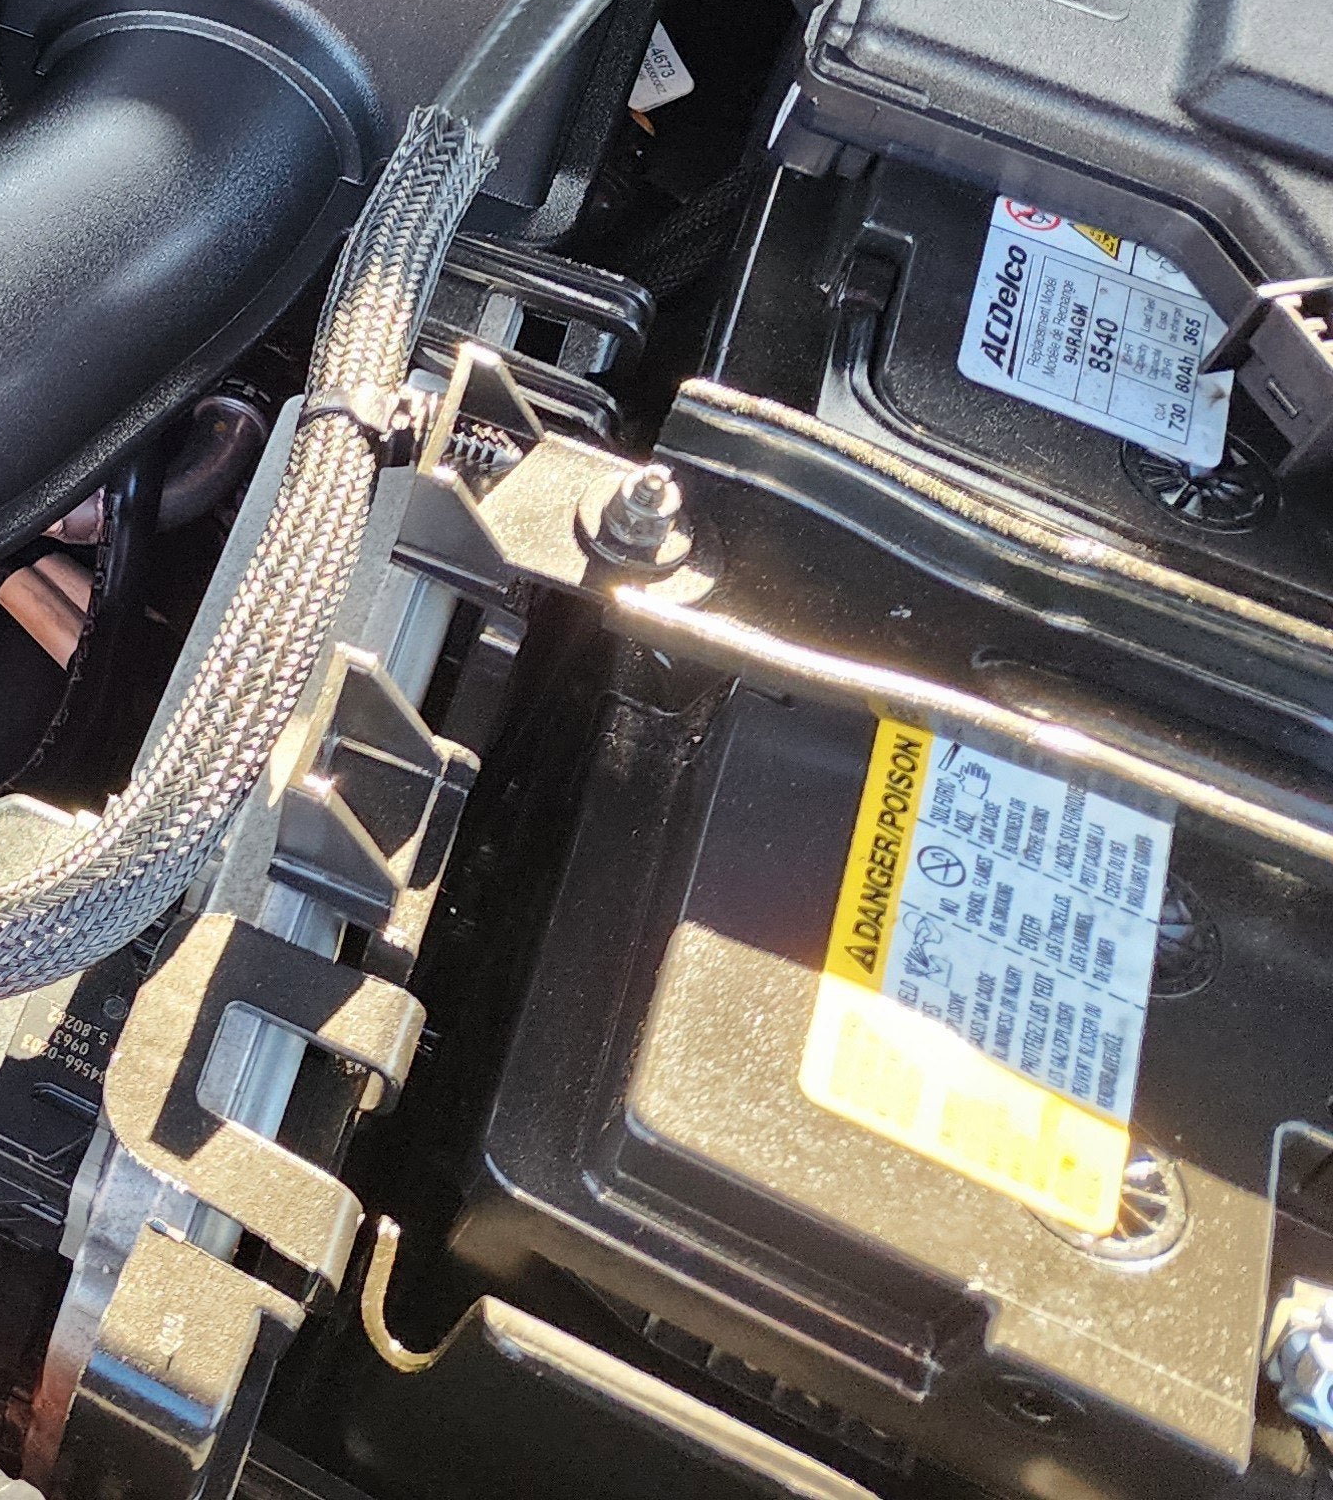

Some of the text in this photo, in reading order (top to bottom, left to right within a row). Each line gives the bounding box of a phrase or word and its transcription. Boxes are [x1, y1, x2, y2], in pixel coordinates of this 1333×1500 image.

[980, 244, 1028, 369] ACDelco
[1051, 278, 1075, 326] Rechange
[1026, 275, 1057, 367] Replacement Model
[1049, 327, 1062, 342] de
[1063, 301, 1089, 365] 94RAGM
[1183, 317, 1200, 345] 365
[1086, 316, 1118, 373] 8540
[1173, 354, 1194, 393] 80Ah
[1168, 403, 1186, 431] 730
[930, 777, 956, 824] SULFURIC
[854, 733, 922, 945] DANGER/POISON
[977, 798, 1001, 845] CAN CAUSE
[1001, 797, 1026, 854] BLINDNESS OR
[972, 854, 993, 889] FLAMES
[1052, 839, 1075, 877] L'ACIDE
[1078, 864, 1097, 888] PEUT
[1088, 822, 1104, 836] LA
[1107, 856, 1124, 871] OU
[938, 896, 960, 916] NO
[988, 881, 1014, 937] OR SMOKING
[1044, 942, 1062, 962] LES
[1068, 953, 1086, 973] LES
[975, 970, 996, 1002] CAUSE
[1031, 972, 1054, 1000] YEUX
[1092, 967, 1110, 983] DE
[1029, 999, 1049, 1023] LES
[54, 1030, 89, 1055] 0963
[1047, 1068, 1065, 1088] LES
